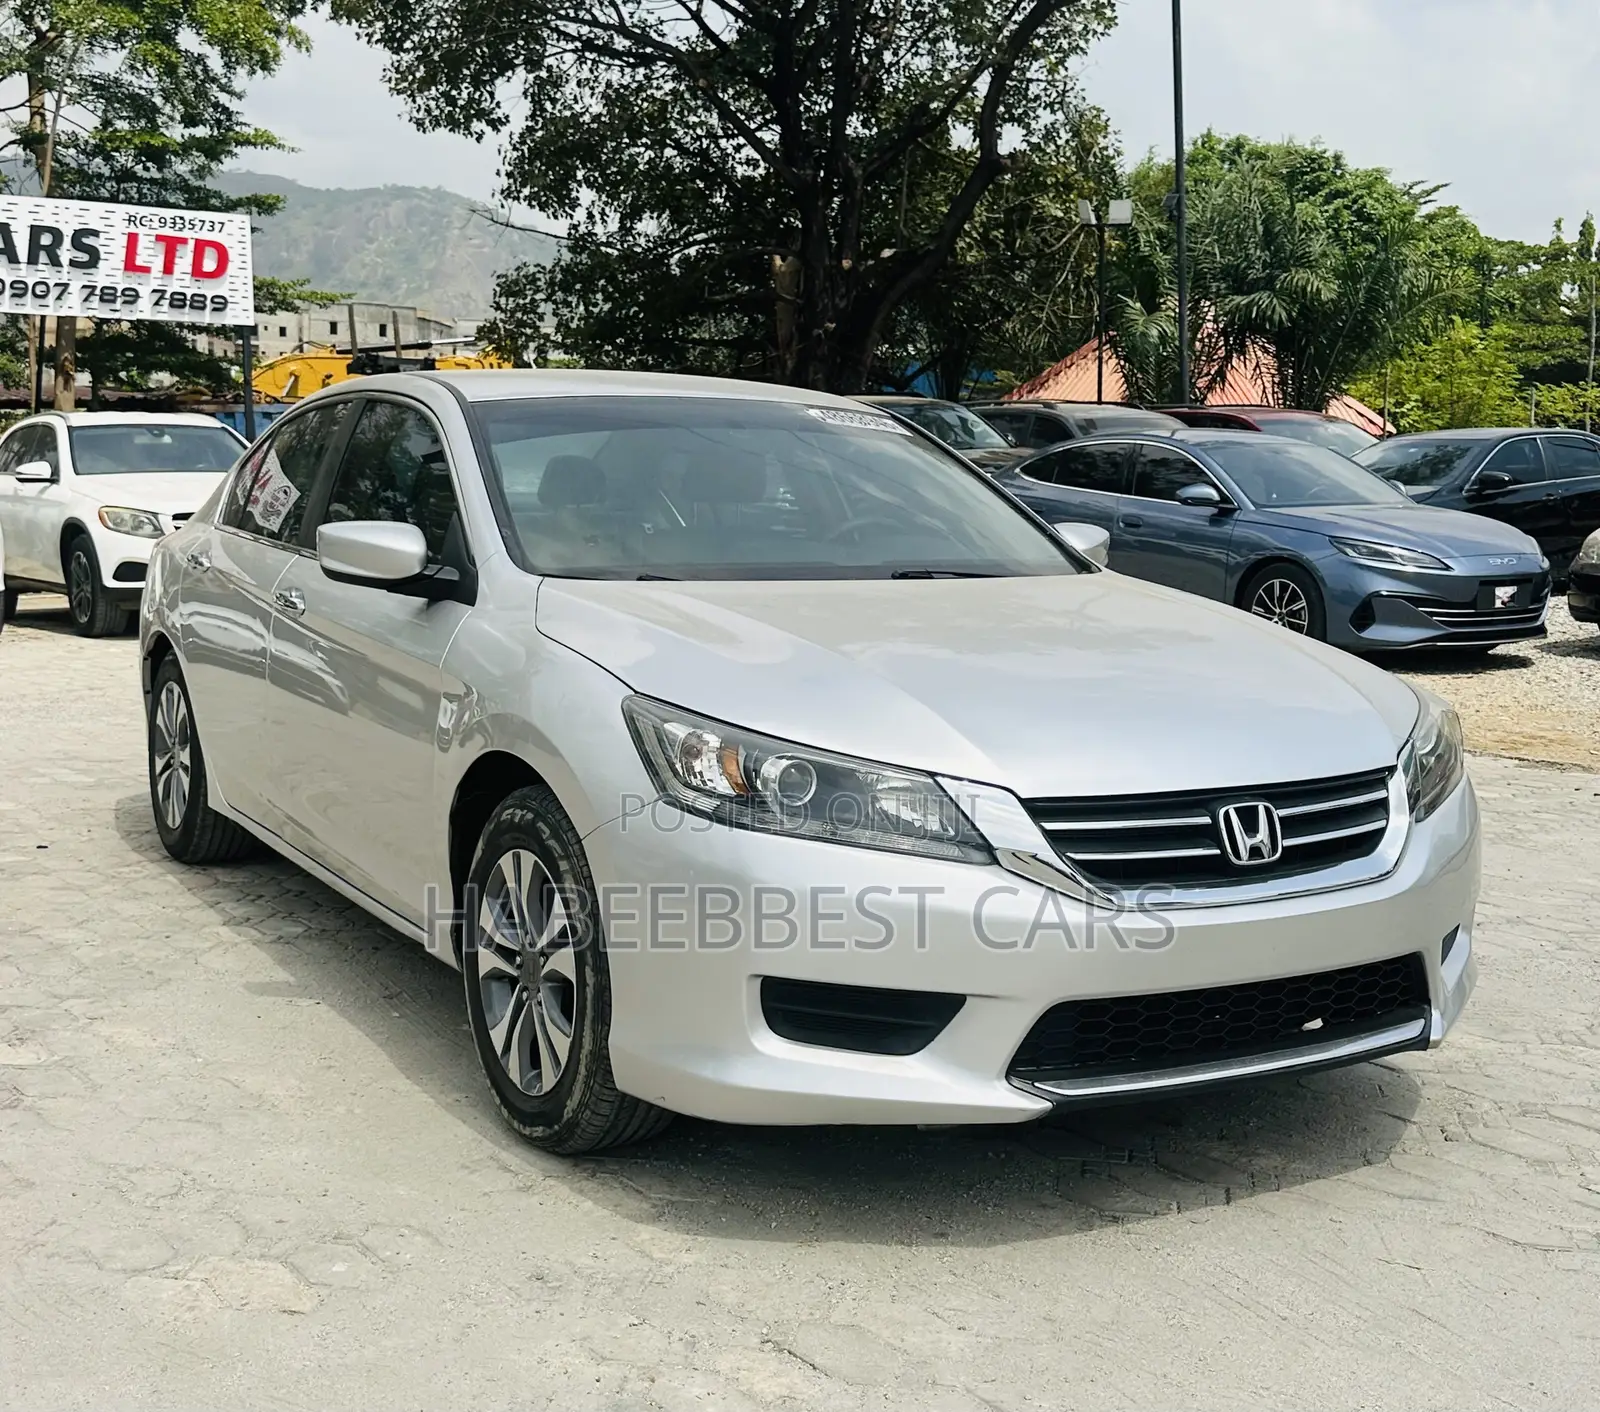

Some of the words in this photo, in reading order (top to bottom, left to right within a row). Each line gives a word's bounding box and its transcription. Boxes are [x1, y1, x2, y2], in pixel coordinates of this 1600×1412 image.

[123, 231, 230, 280] LTD
[0, 278, 71, 302] 907
[80, 284, 141, 305] 789
[151, 288, 229, 312] 7889
[1487, 557, 1517, 566] BYD
